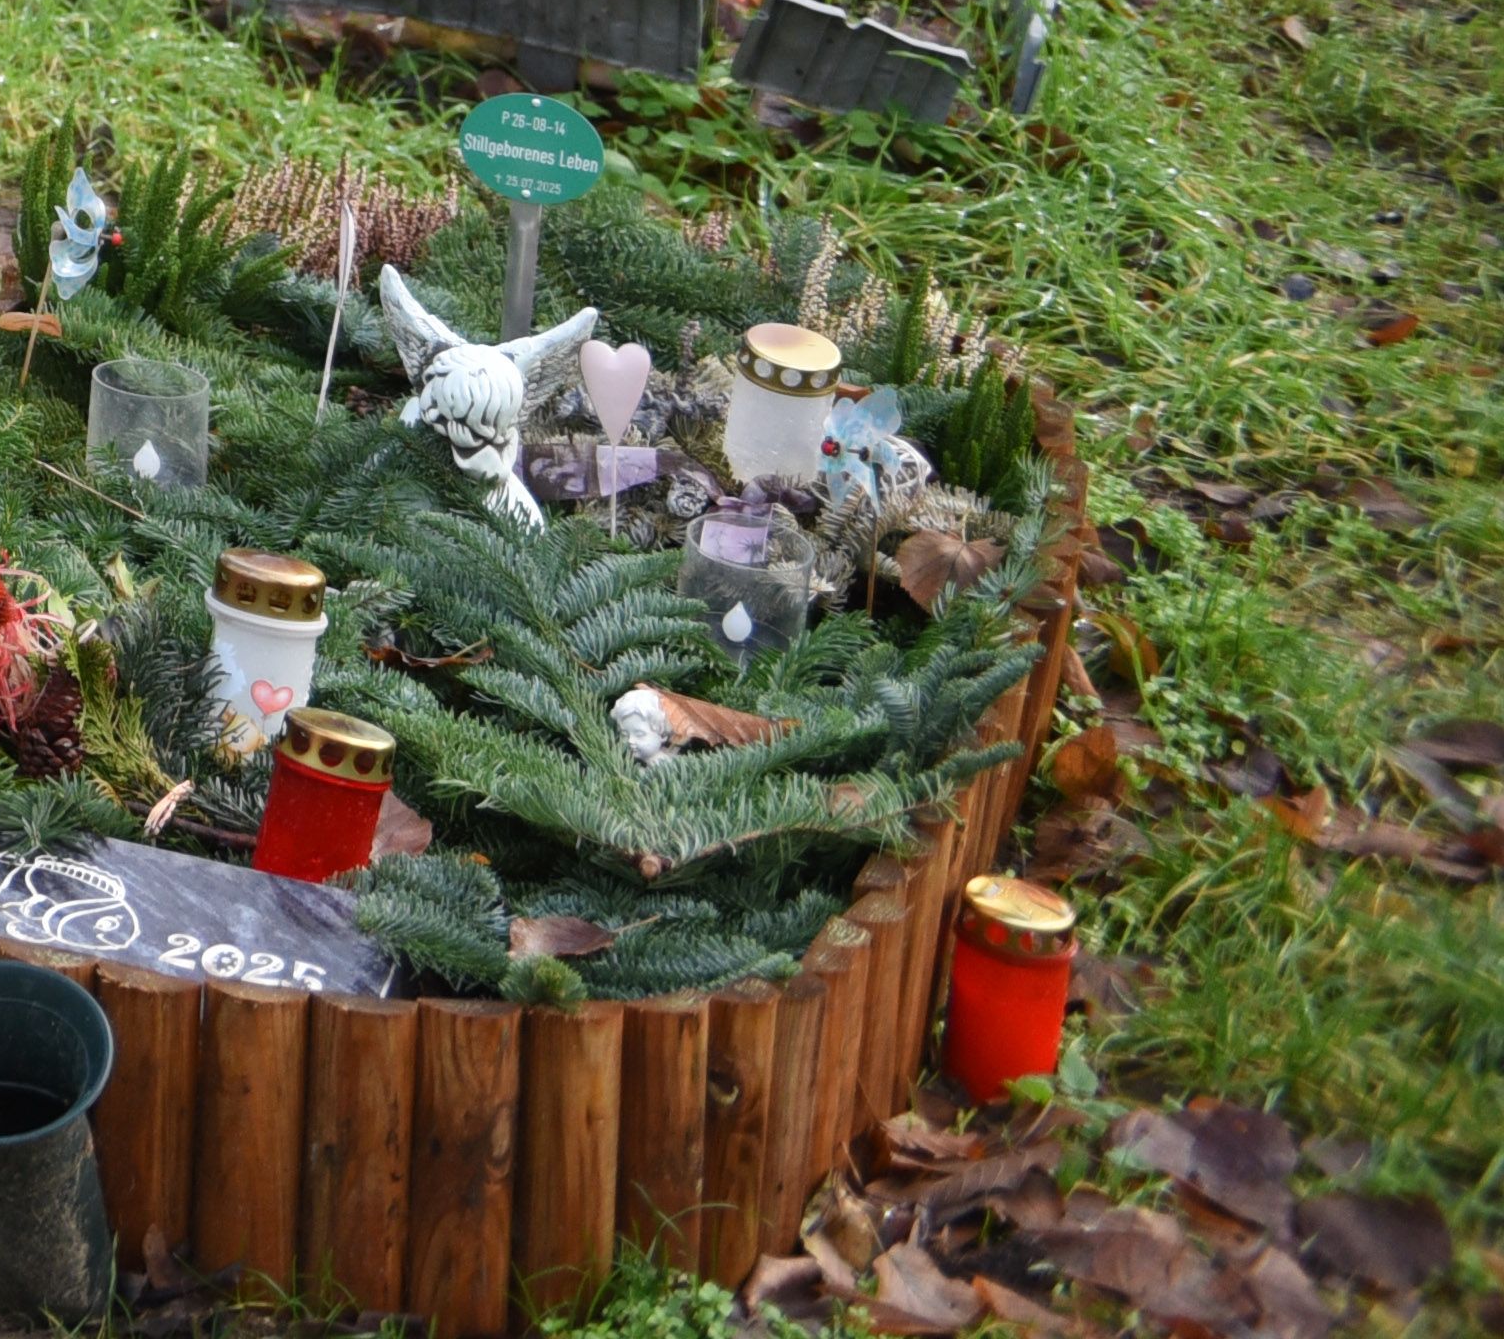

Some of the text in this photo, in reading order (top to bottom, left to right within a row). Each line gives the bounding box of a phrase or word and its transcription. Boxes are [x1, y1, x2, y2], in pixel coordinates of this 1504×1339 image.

[501, 110, 566, 136] P 26-08-14
[463, 133, 599, 174] Stillgeborenes Leben
[158, 933, 327, 991] 2025
